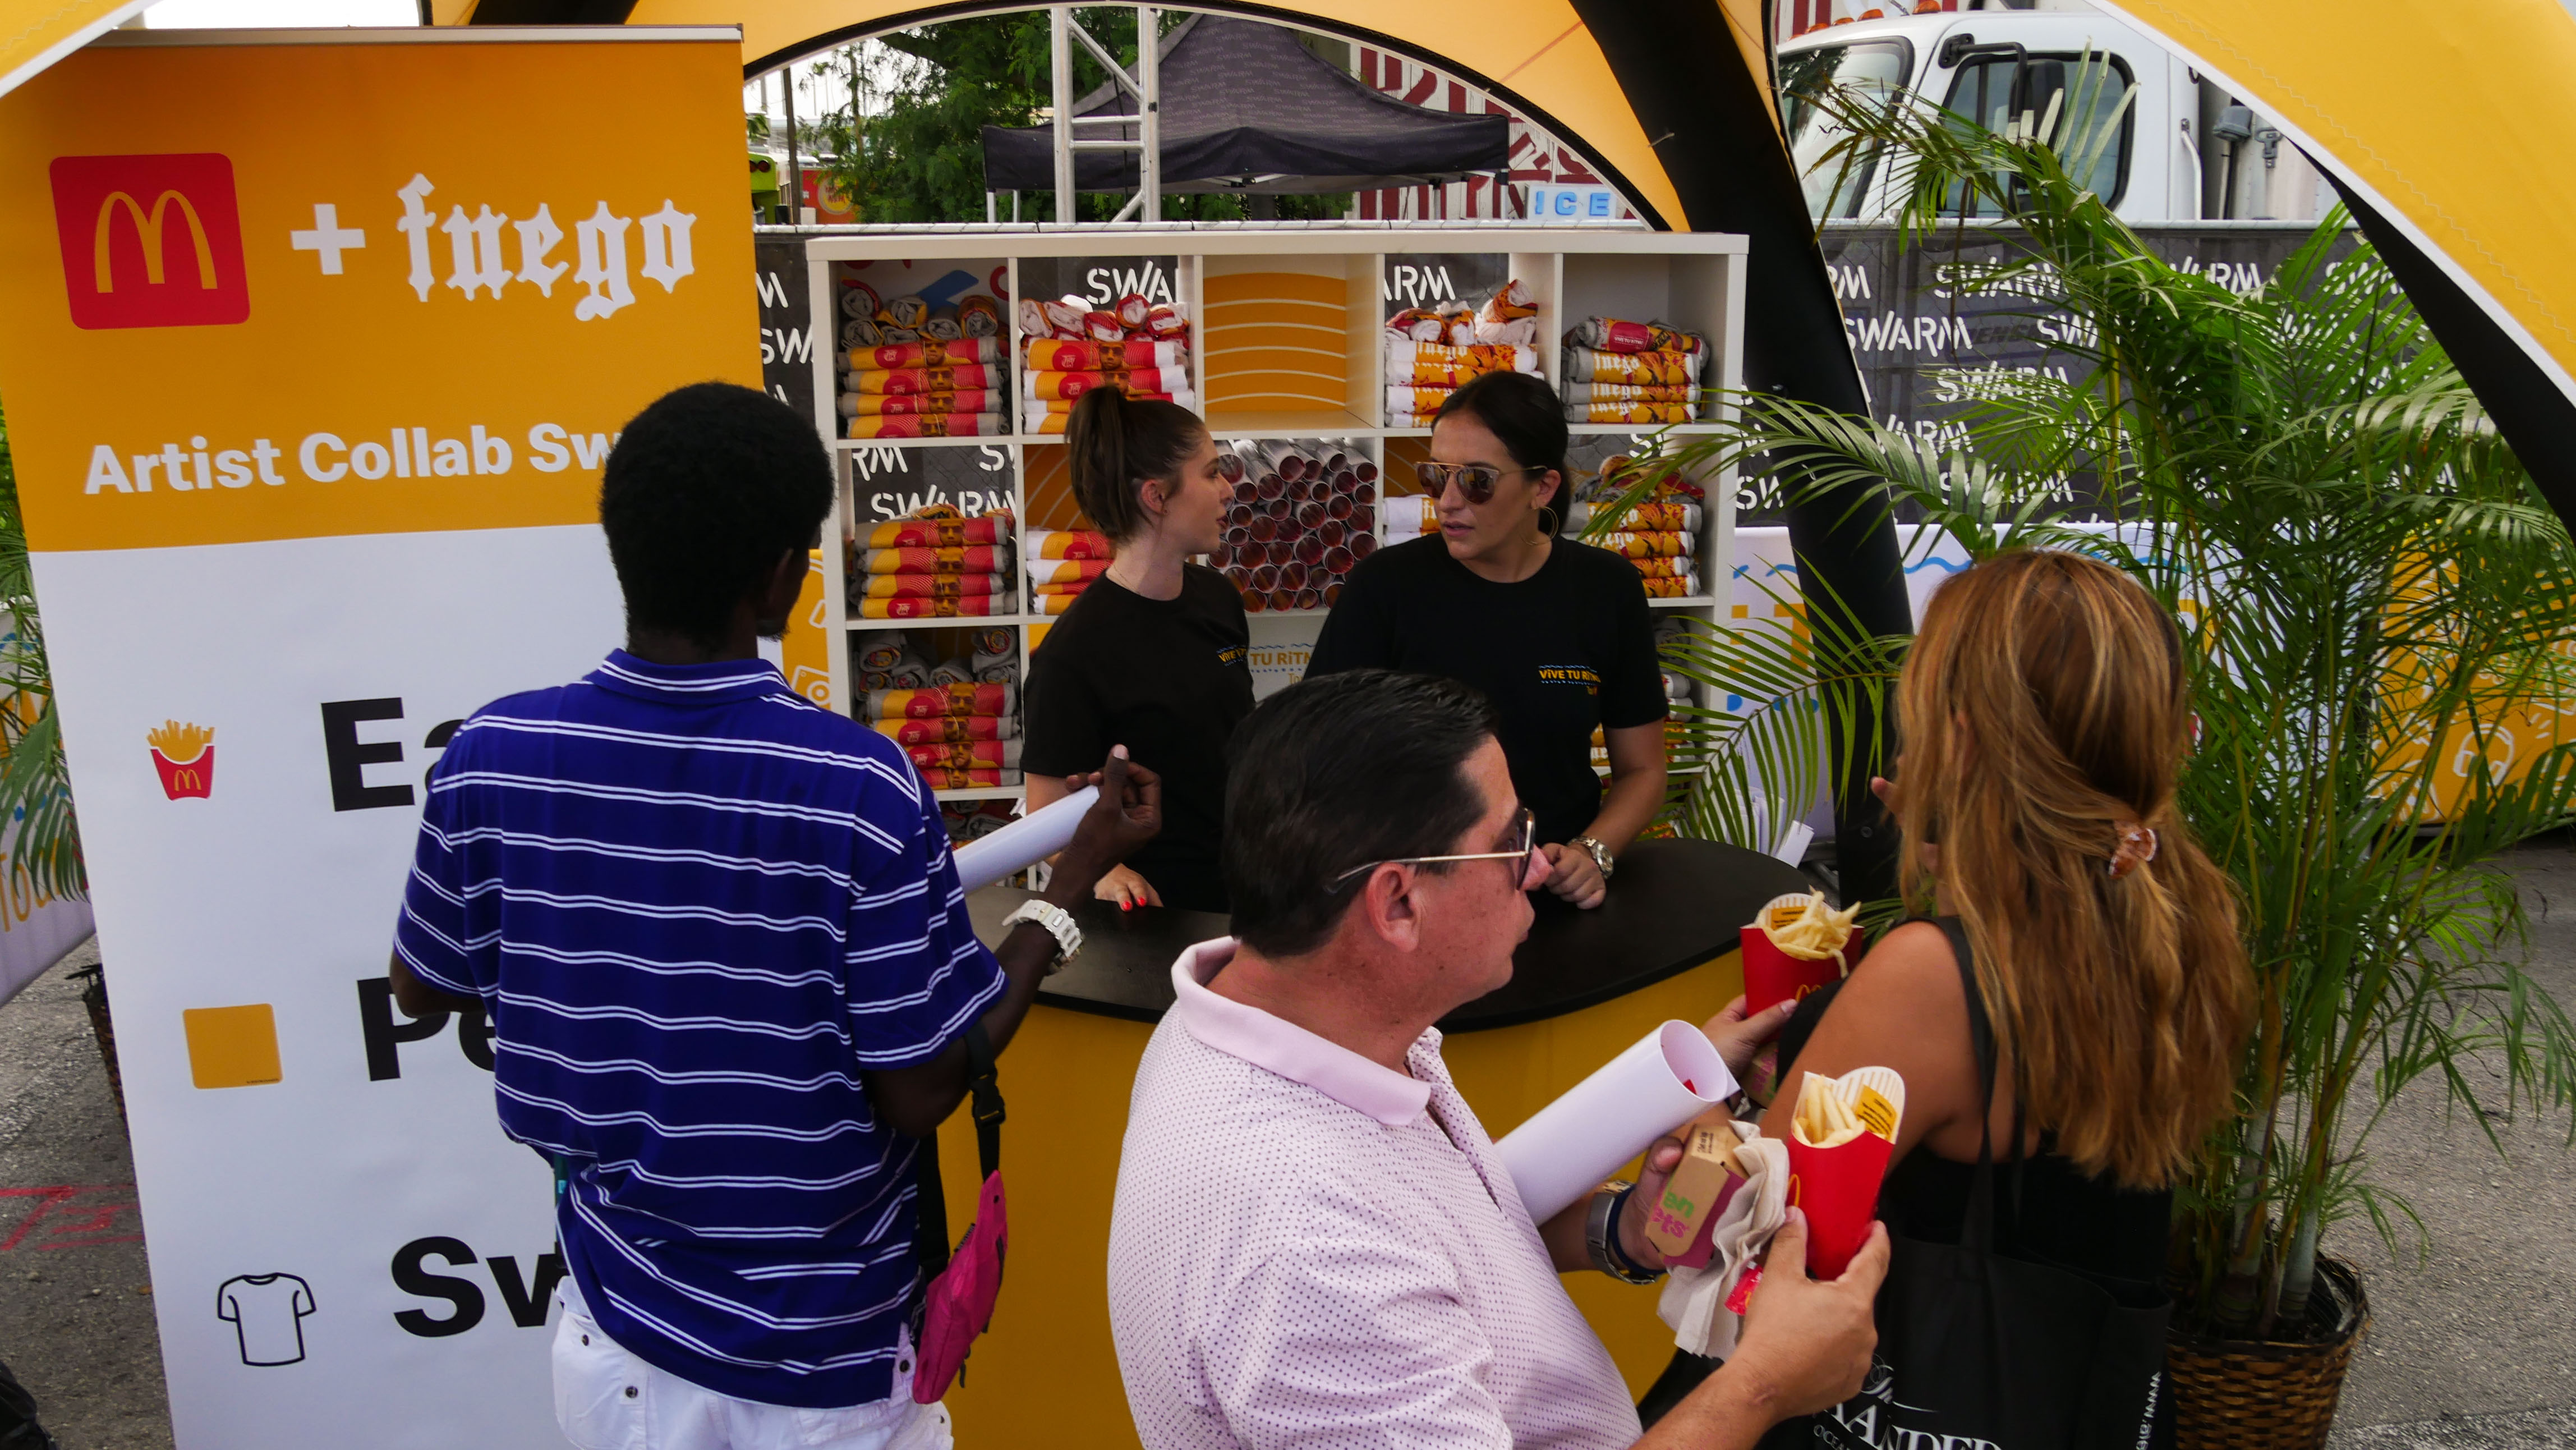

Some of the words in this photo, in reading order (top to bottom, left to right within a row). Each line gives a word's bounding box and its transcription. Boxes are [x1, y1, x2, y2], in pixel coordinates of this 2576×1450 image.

[1535, 191, 1611, 217] ICE
[396, 173, 698, 322] fuego
[1086, 260, 1178, 305] SWA
[84, 434, 284, 495] Artist
[299, 424, 513, 483] Collab
[528, 423, 623, 473] Sw
[1250, 652, 1272, 666] TU
[1566, 669, 1580, 680] TU
[357, 977, 497, 1081] Pe
[391, 1236, 564, 1338] Sw
